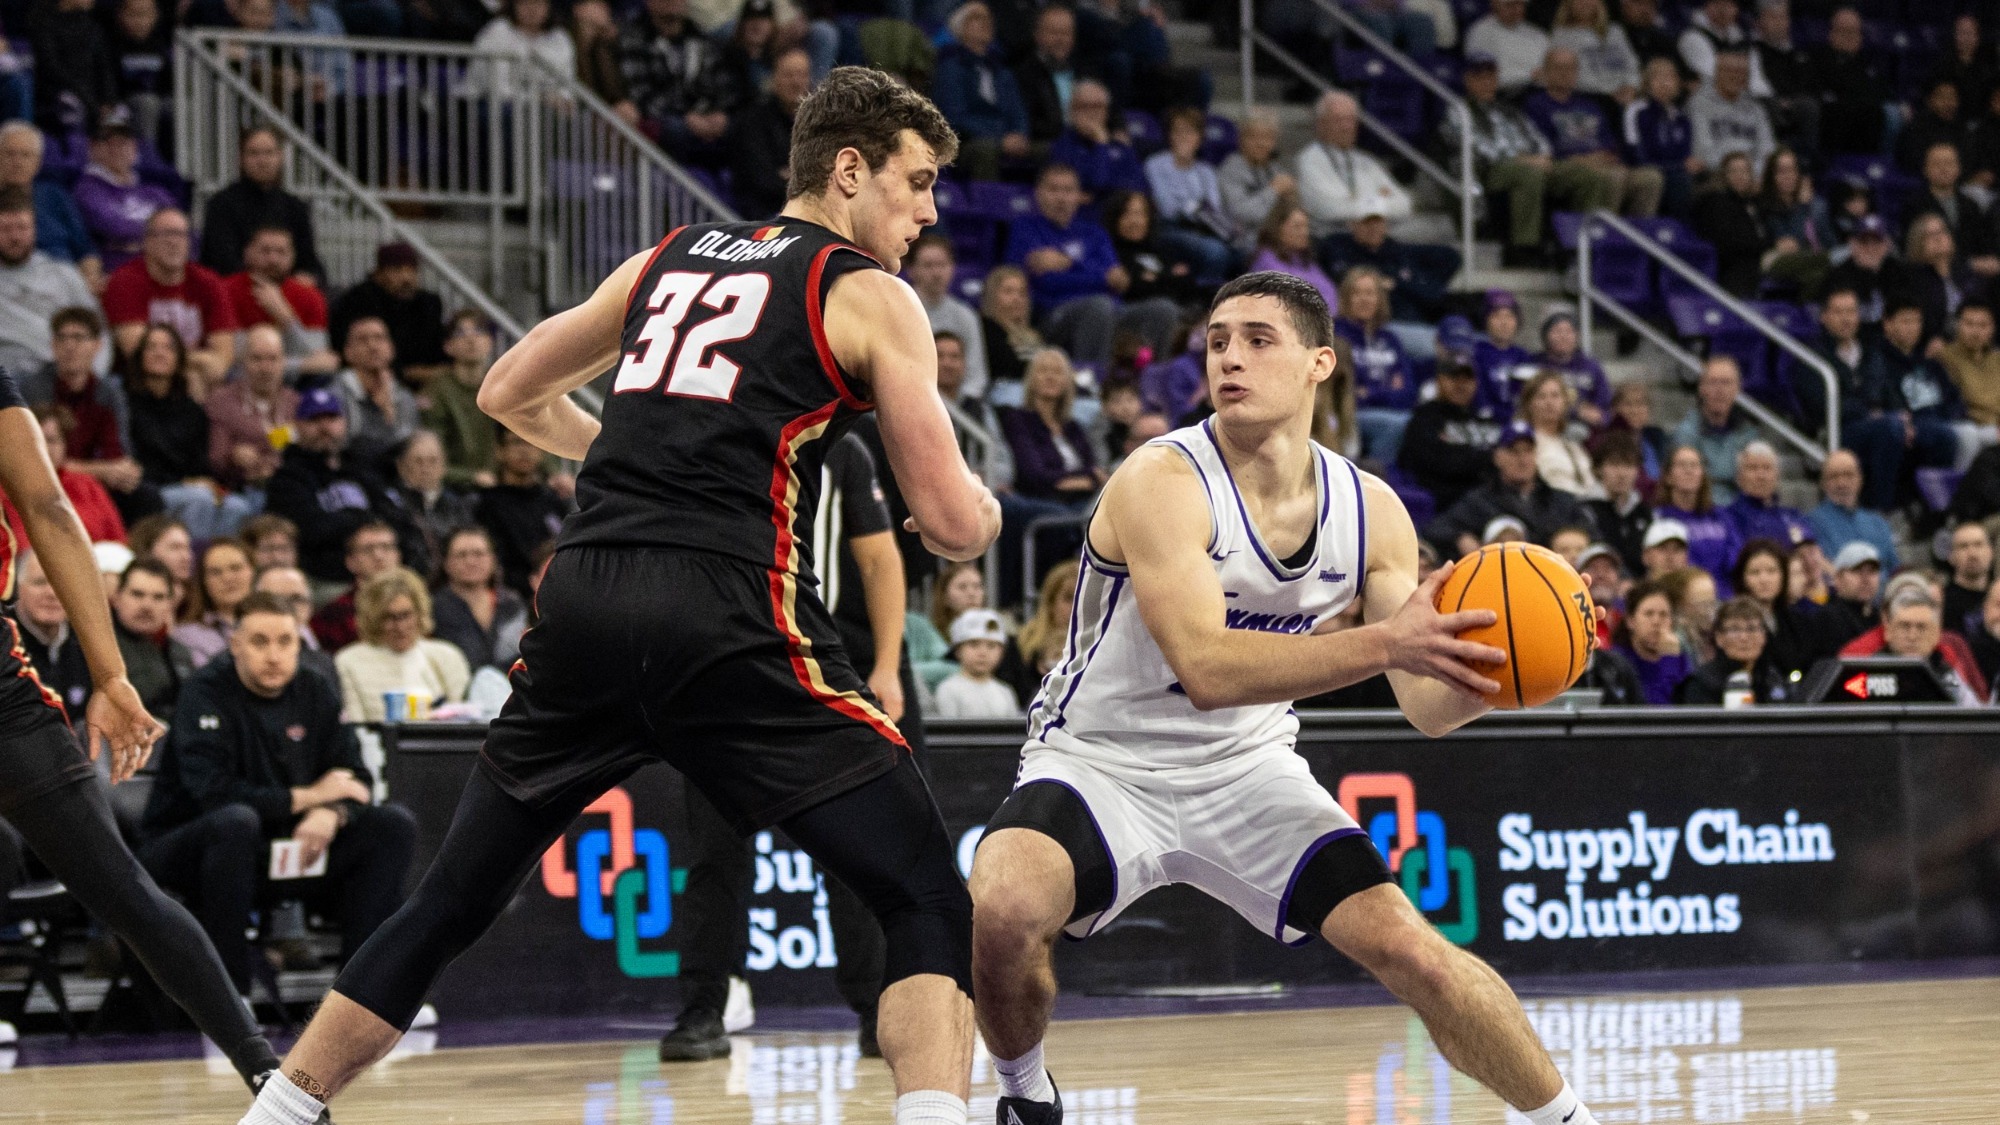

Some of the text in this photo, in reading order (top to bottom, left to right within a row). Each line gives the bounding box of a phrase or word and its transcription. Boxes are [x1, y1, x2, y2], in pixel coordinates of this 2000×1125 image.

[688, 230, 802, 262] OLDHAM
[613, 270, 772, 404] 32
[1867, 674, 1897, 696] POSS
[1498, 808, 1835, 882] Supply Chain
[1503, 881, 1742, 941] Solutions
